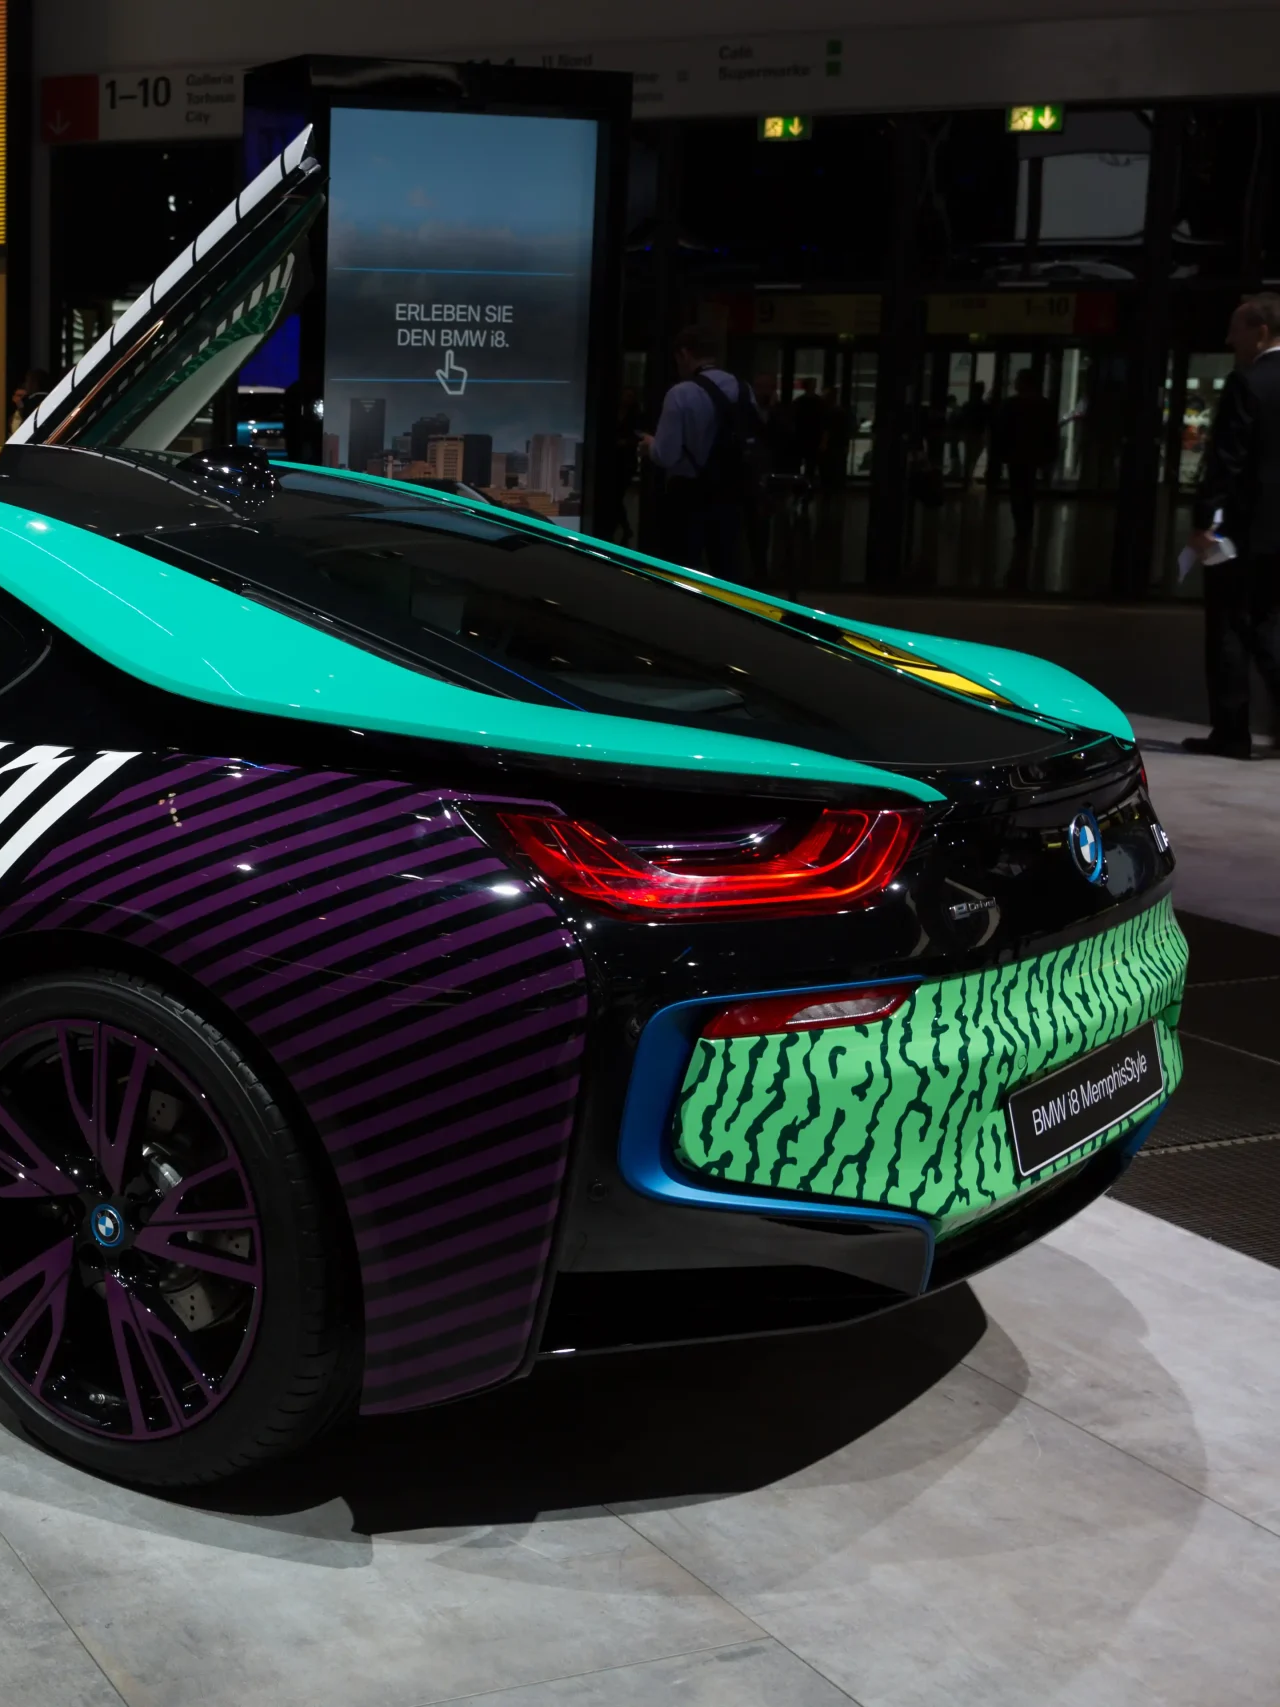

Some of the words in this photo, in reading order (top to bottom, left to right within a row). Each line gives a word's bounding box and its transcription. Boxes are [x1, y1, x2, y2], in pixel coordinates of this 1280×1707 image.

[395, 302, 481, 323] ERLEBEN
[484, 304, 514, 324] SIE
[397, 328, 436, 347] DEN
[440, 328, 487, 348] BMW
[490, 329, 510, 348] i8.
[1031, 1093, 1067, 1137] BMW
[1067, 1088, 1080, 1117] i8
[1080, 1050, 1148, 1110] MemphisStyle
